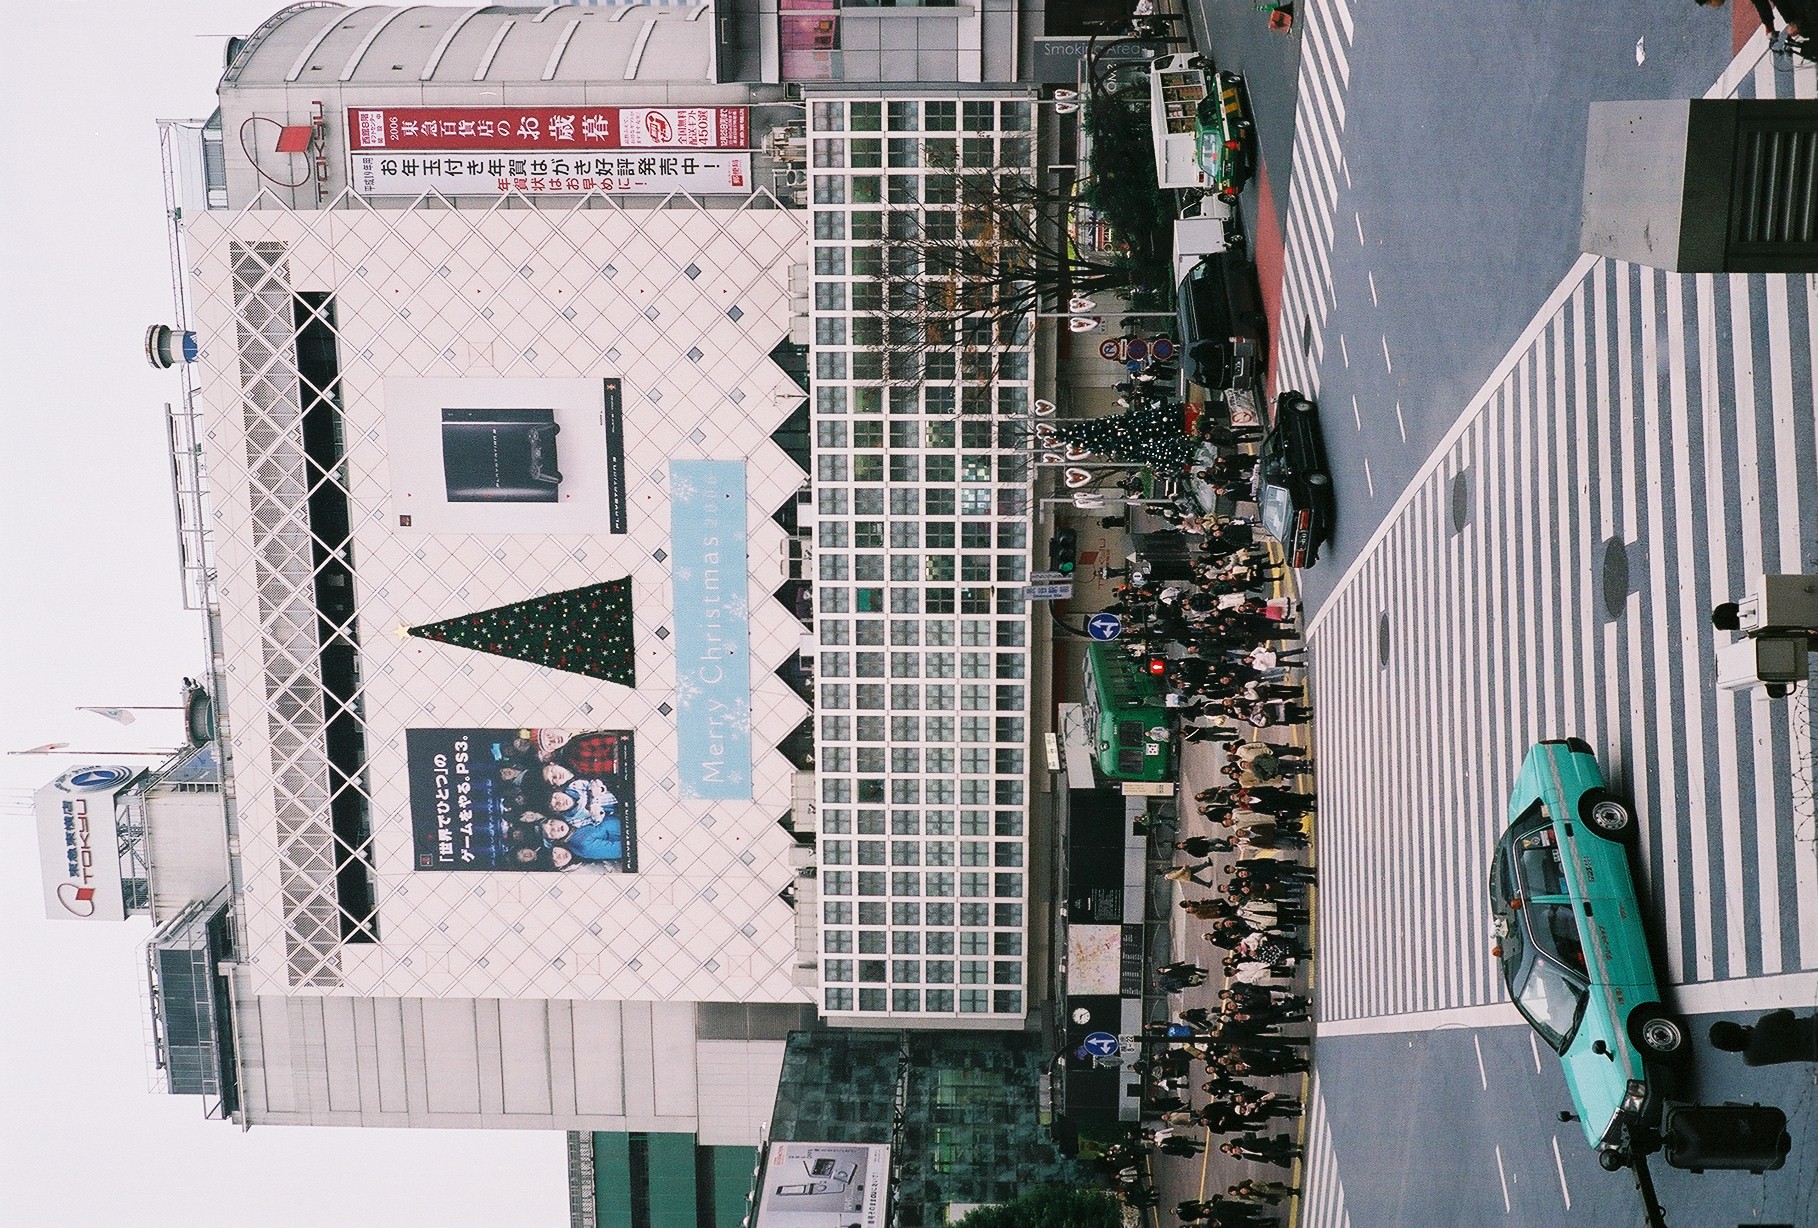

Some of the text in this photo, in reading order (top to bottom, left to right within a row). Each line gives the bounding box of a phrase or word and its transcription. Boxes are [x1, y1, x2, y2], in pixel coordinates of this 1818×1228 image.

[361, 113, 370, 144] 西館8階
[389, 116, 400, 141] 2006
[402, 114, 609, 142] 東急百貨店のお歳暮
[678, 111, 688, 144] 全国無料
[688, 110, 698, 145] 配送ギフト
[698, 110, 708, 145] 450選
[312, 101, 328, 202] TOKYU
[380, 158, 720, 176] お年玉付き年賀はがき好評発売中!
[362, 158, 375, 192] 平成19年用
[498, 178, 647, 192] 年賀状はお早めに!
[700, 536, 722, 684] Christmas
[702, 699, 728, 782] Merry
[434, 753, 454, 862] 「世界でひとつ」の
[454, 735, 476, 862] ゲームをやる。PS3。
[62, 800, 80, 877] 東急東横店
[76, 798, 94, 885] TOKYU
